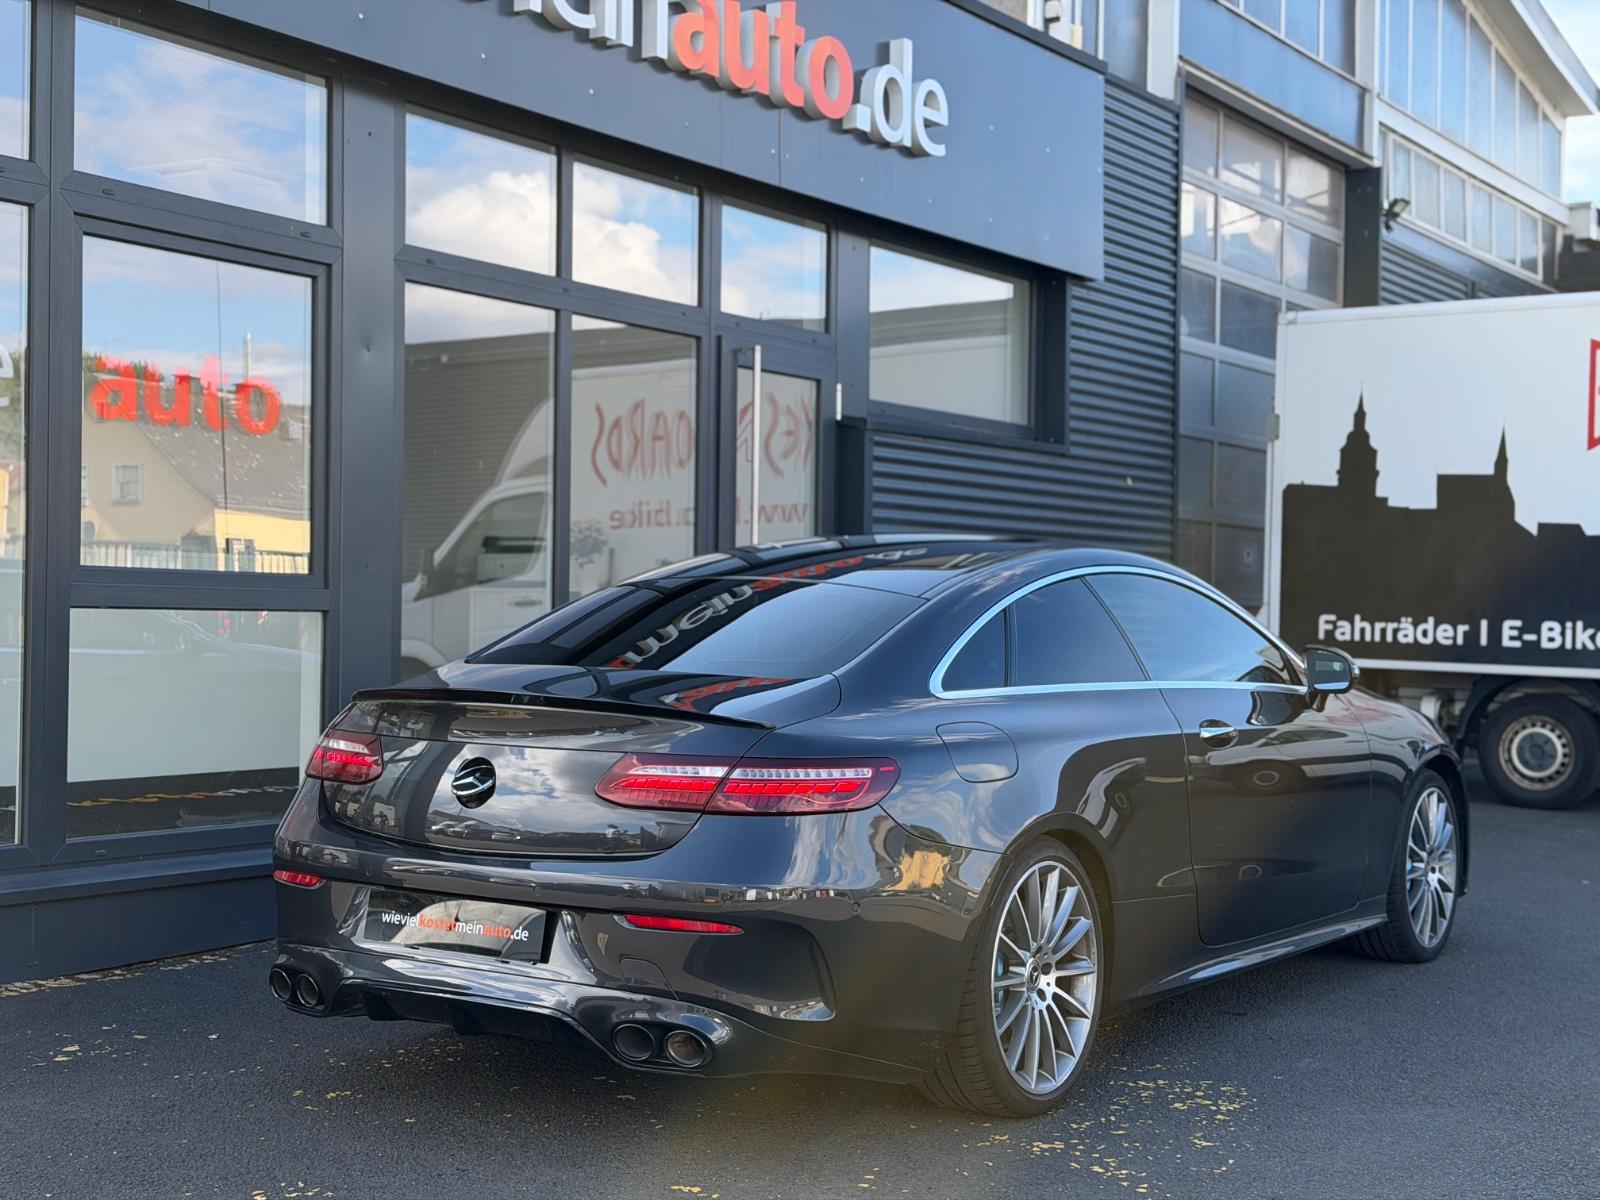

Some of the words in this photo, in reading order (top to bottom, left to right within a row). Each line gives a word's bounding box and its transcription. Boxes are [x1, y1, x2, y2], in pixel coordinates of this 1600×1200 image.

[90, 355, 281, 436] auto
[1317, 613, 1470, 646] Fahrräder
[1501, 618, 1600, 651] E-Bik
